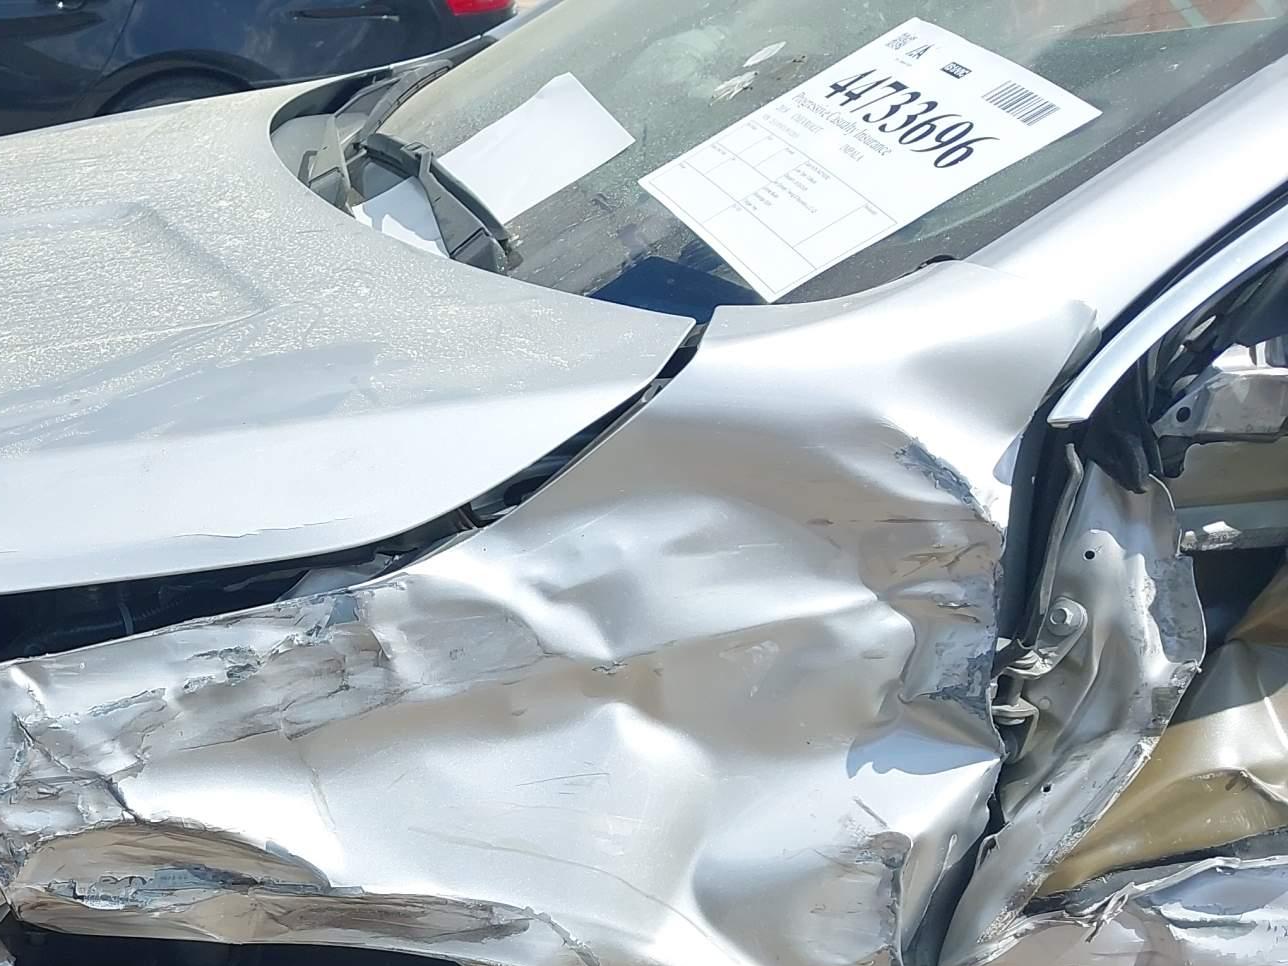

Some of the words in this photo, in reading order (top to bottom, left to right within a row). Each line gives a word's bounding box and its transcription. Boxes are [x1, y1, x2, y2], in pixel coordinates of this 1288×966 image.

[824, 67, 1001, 169] 44733696
[825, 111, 860, 136] Casualty
[853, 129, 893, 157] Insurance
